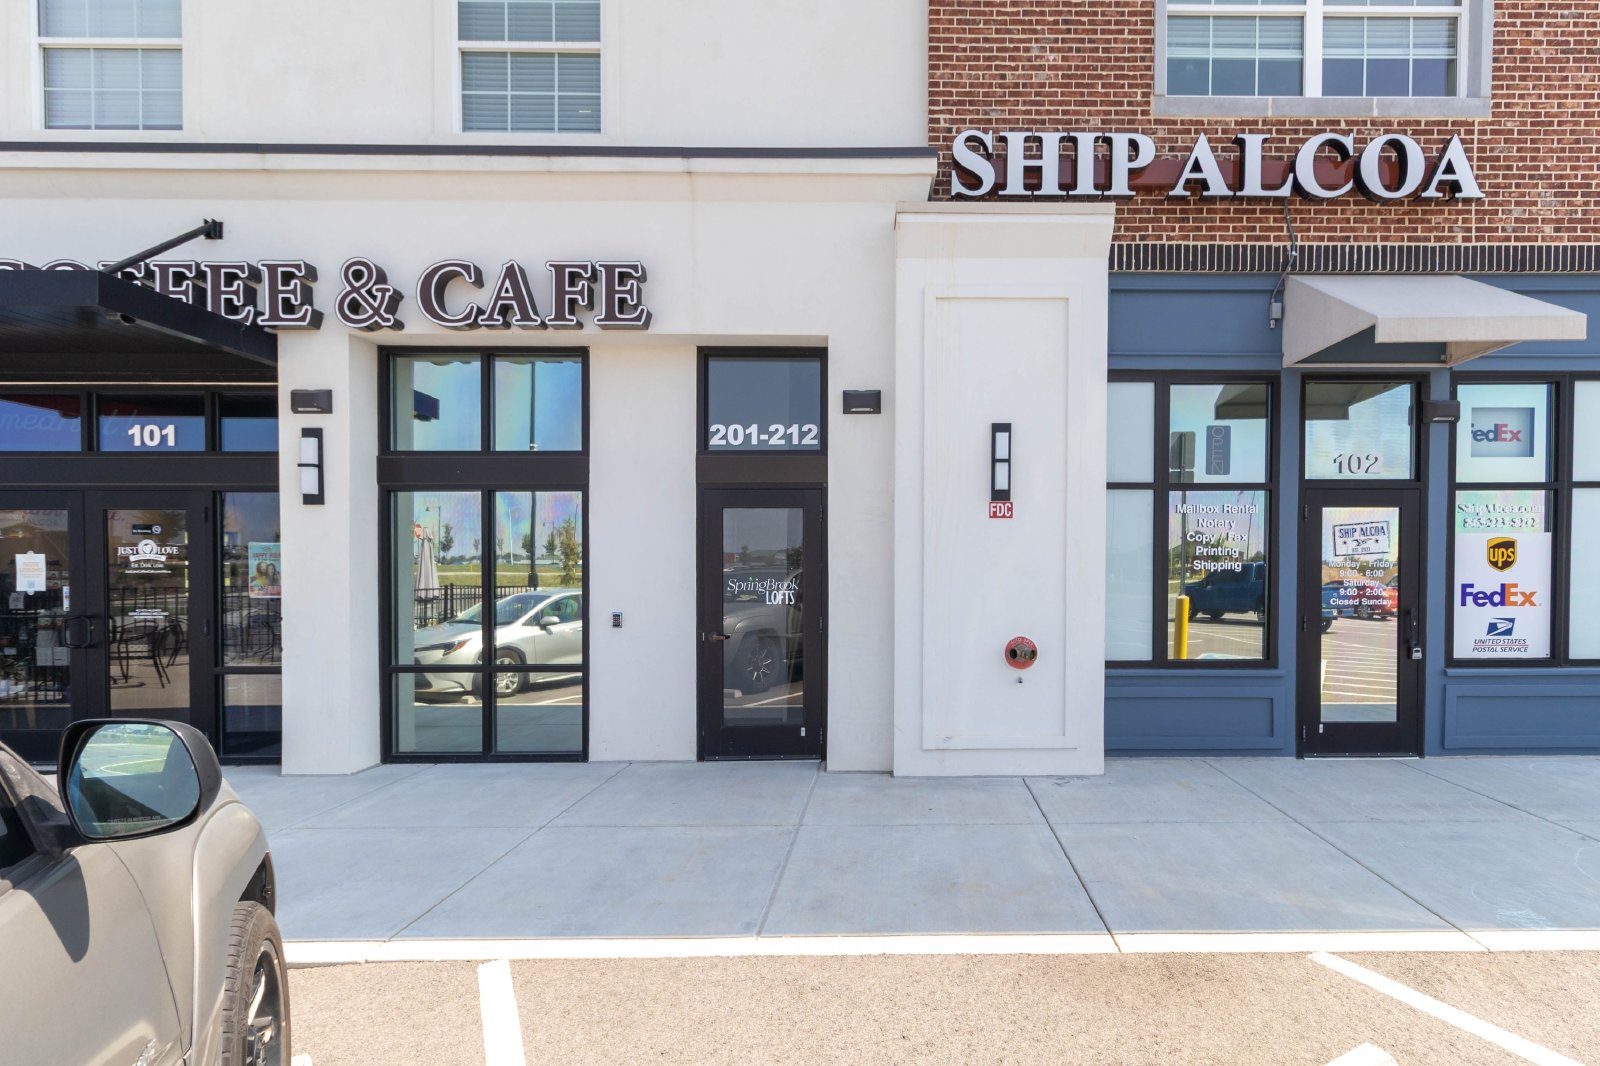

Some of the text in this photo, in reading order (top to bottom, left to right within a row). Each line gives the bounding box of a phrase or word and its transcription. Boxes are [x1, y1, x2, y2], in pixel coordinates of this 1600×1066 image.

[951, 130, 1485, 198] SHIP ALCOA
[335, 256, 398, 328] &
[416, 259, 650, 328] CAFE
[128, 424, 175, 447] 101
[709, 423, 819, 446] 201-212
[1471, 423, 1522, 442] edEx
[1211, 426, 1225, 475] OPEN
[1333, 453, 1382, 475] 102
[990, 503, 1012, 517] FDC
[1176, 503, 1259, 514] Mailbox Rental
[1197, 518, 1236, 529] Notary
[1186, 532, 1217, 543] Copy
[1227, 531, 1248, 542] Fax
[1339, 525, 1386, 538] SHIP ALCOA
[117, 546, 179, 555] JUST LOVE
[1195, 546, 1239, 558] Printing
[1489, 548, 1515, 567] ups
[1193, 560, 1242, 572] Shipping
[1328, 560, 1360, 569] Monday
[1368, 560, 1394, 569] Friday
[727, 578, 800, 594] SpringBrook
[1344, 578, 1380, 588] Saturday
[766, 591, 795, 605] LOFTS
[1460, 583, 1538, 607] FedEx
[1361, 598, 1392, 607] Sunday
